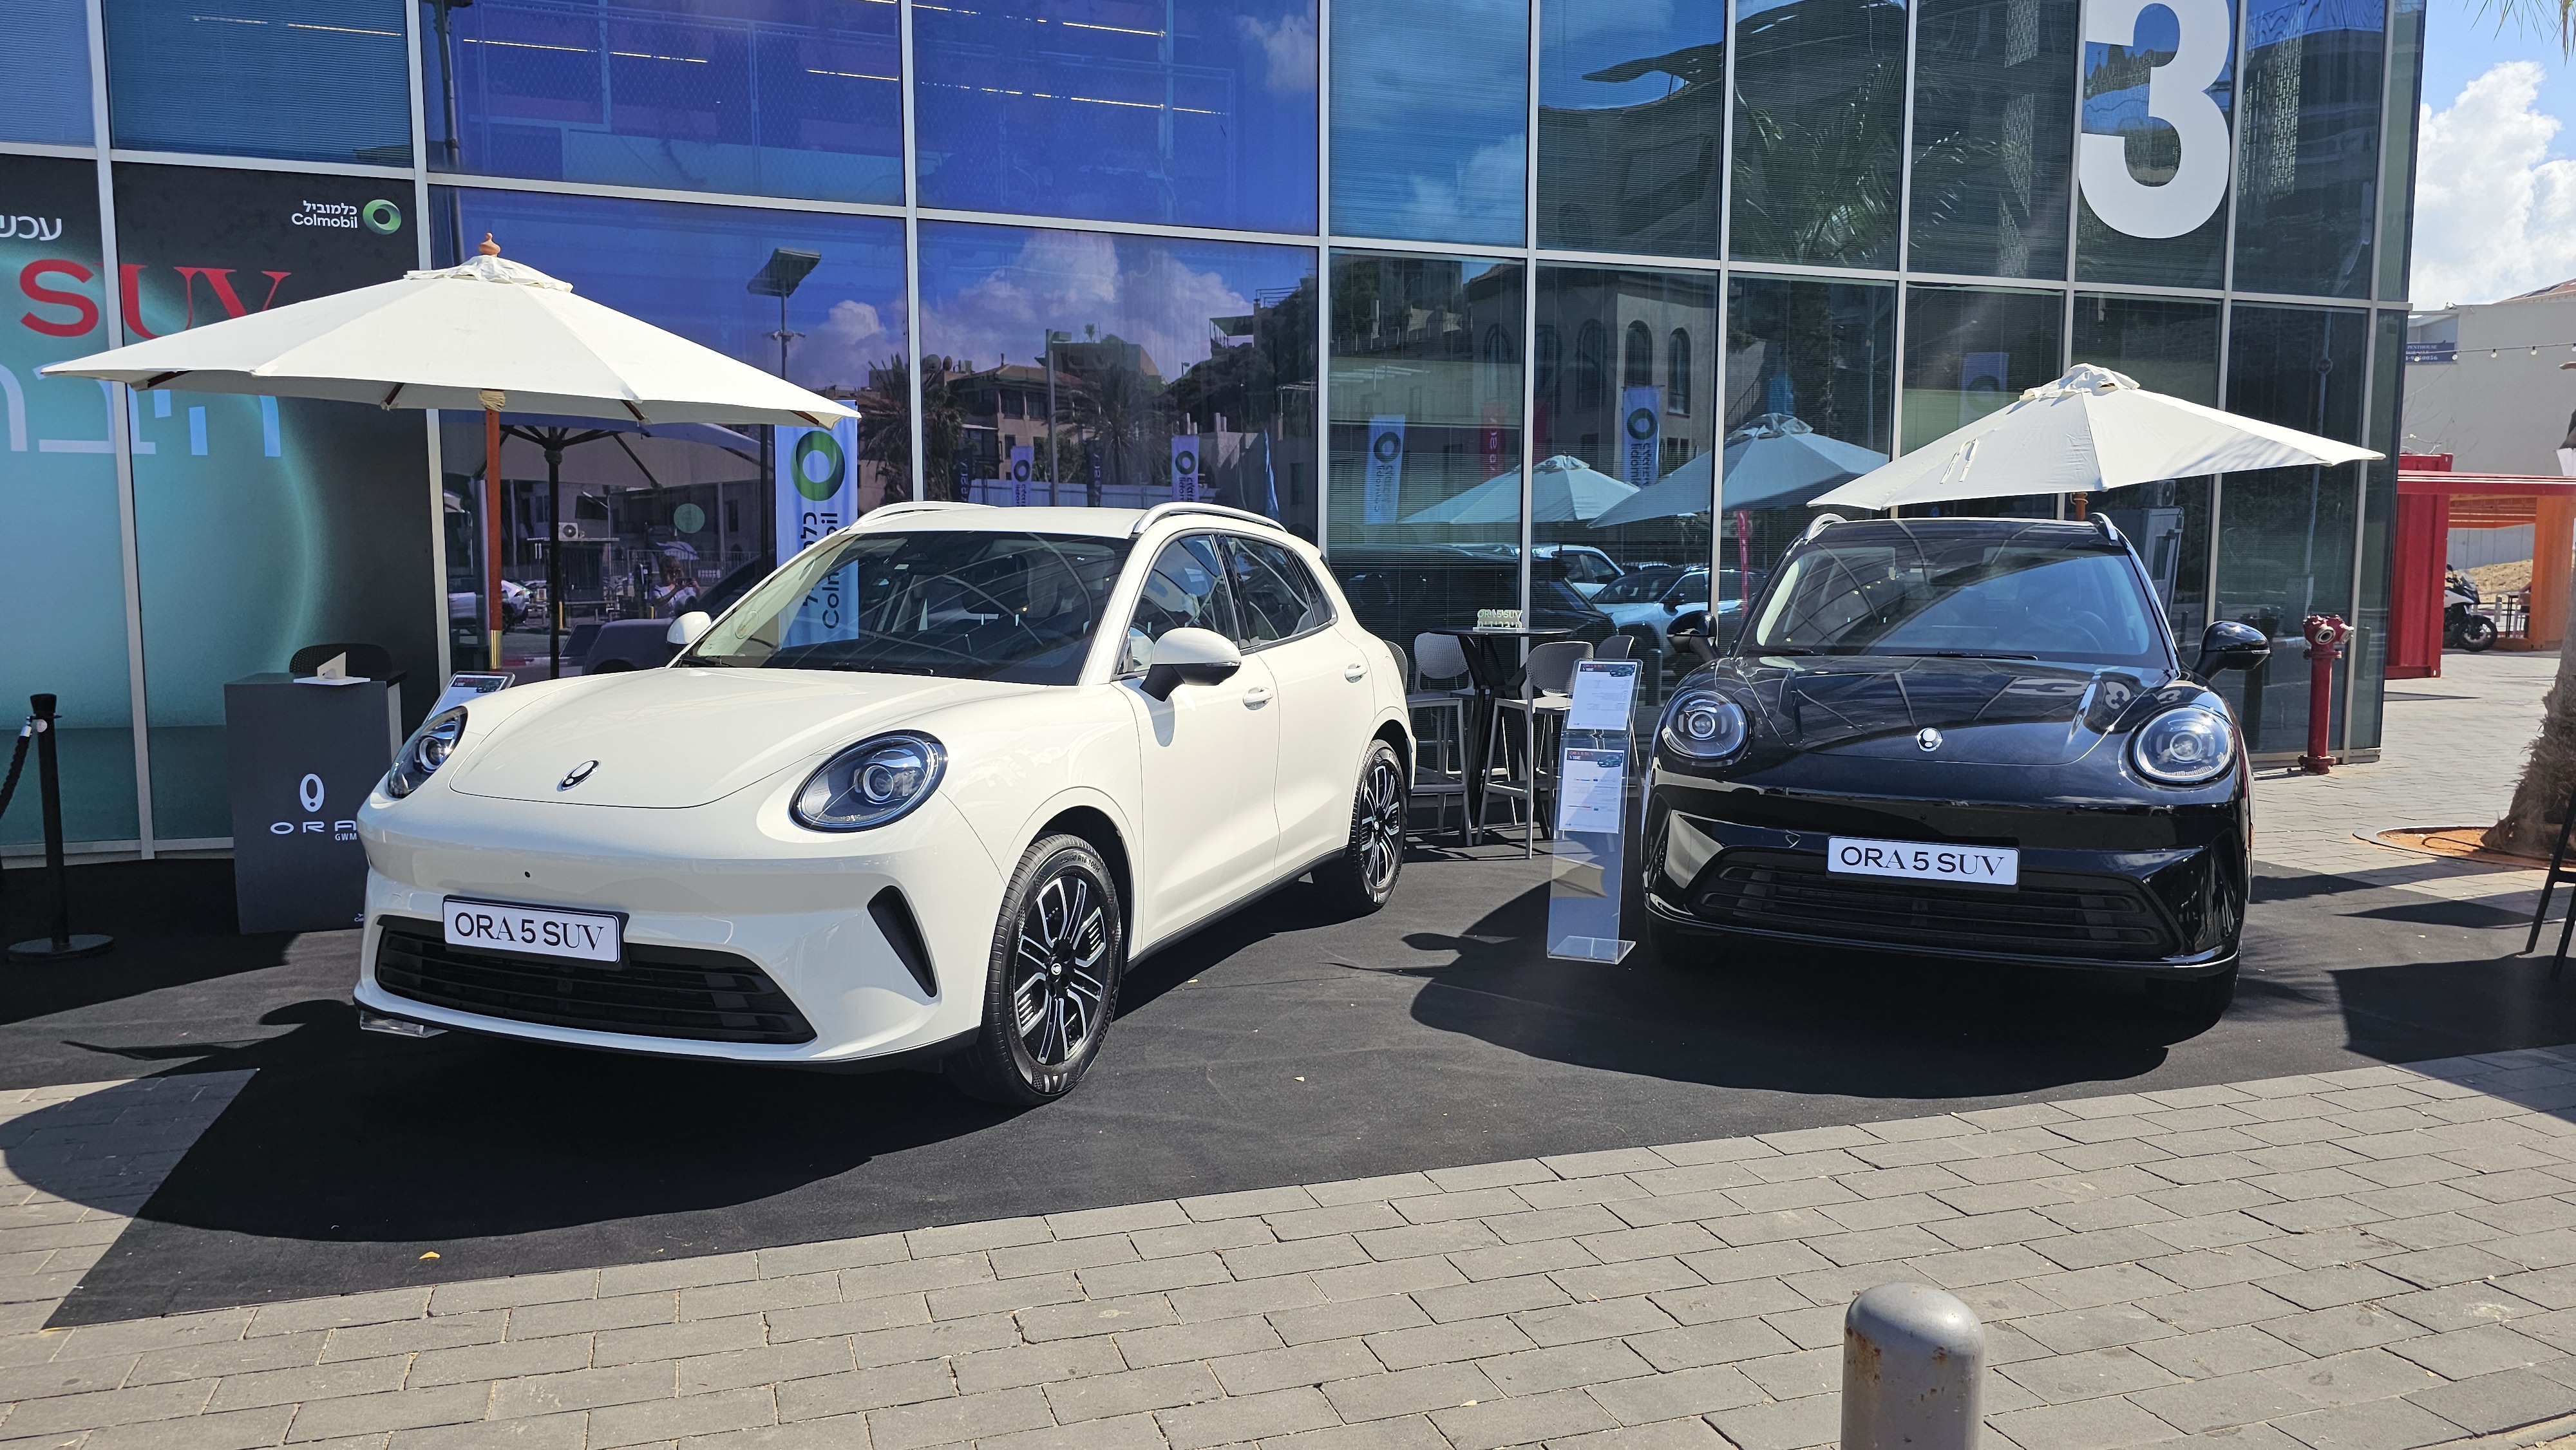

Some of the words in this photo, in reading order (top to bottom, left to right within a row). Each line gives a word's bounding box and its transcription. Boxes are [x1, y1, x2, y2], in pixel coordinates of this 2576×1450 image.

[2079, 0, 2230, 238] 3
[303, 200, 357, 215] כלמוביל
[291, 213, 358, 229] Colmobil
[19, 259, 291, 339] SUV
[1477, 609, 1496, 617] ORA
[1497, 609, 1503, 618] 5
[1503, 609, 1522, 618] SUV
[270, 820, 357, 834] ORA
[335, 833, 357, 841] GWM
[1841, 846, 1908, 869] ORA
[1913, 851, 1929, 871] 5
[1937, 852, 2005, 876] SUV
[455, 912, 517, 942] ORA
[520, 918, 536, 944] 5
[542, 921, 604, 951] SUV
